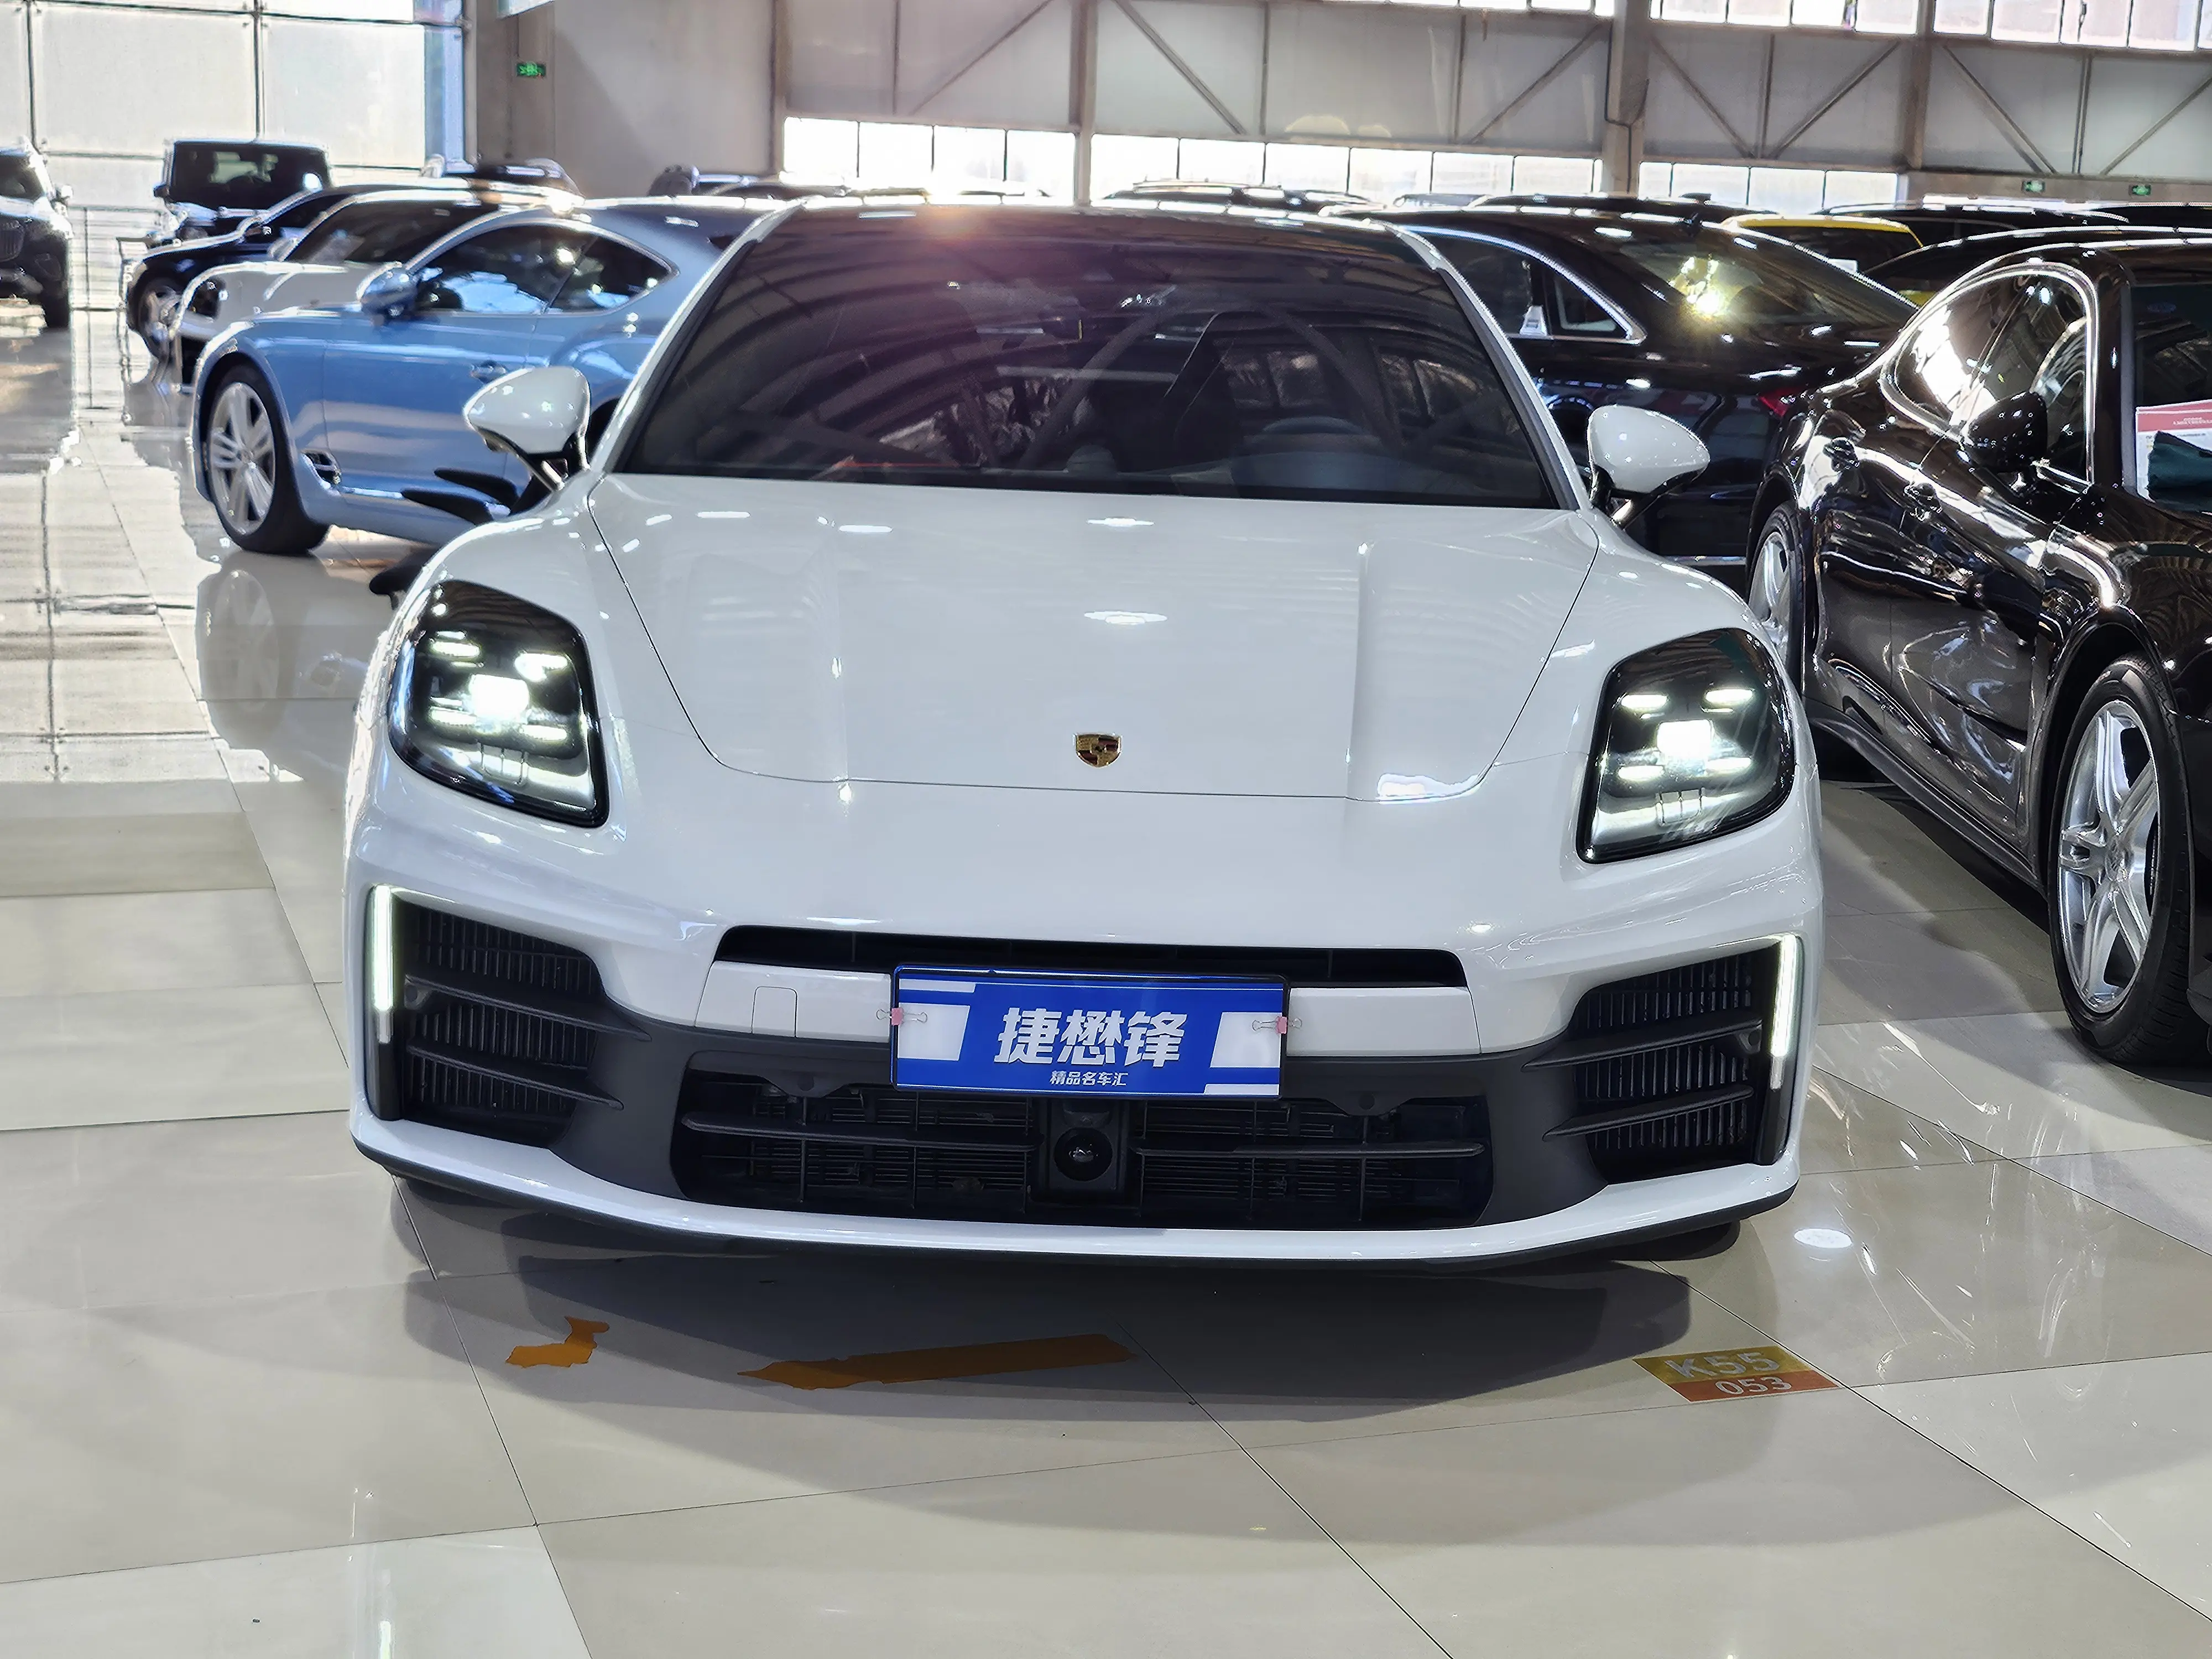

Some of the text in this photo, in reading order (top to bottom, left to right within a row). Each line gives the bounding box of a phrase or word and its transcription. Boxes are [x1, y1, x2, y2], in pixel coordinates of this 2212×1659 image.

[994, 1007, 1188, 1068] 捷懋锋
[1050, 1070, 1129, 1087] 精品名车汇
[1663, 1352, 1780, 1378] K55
[1715, 1376, 1792, 1395] 053
